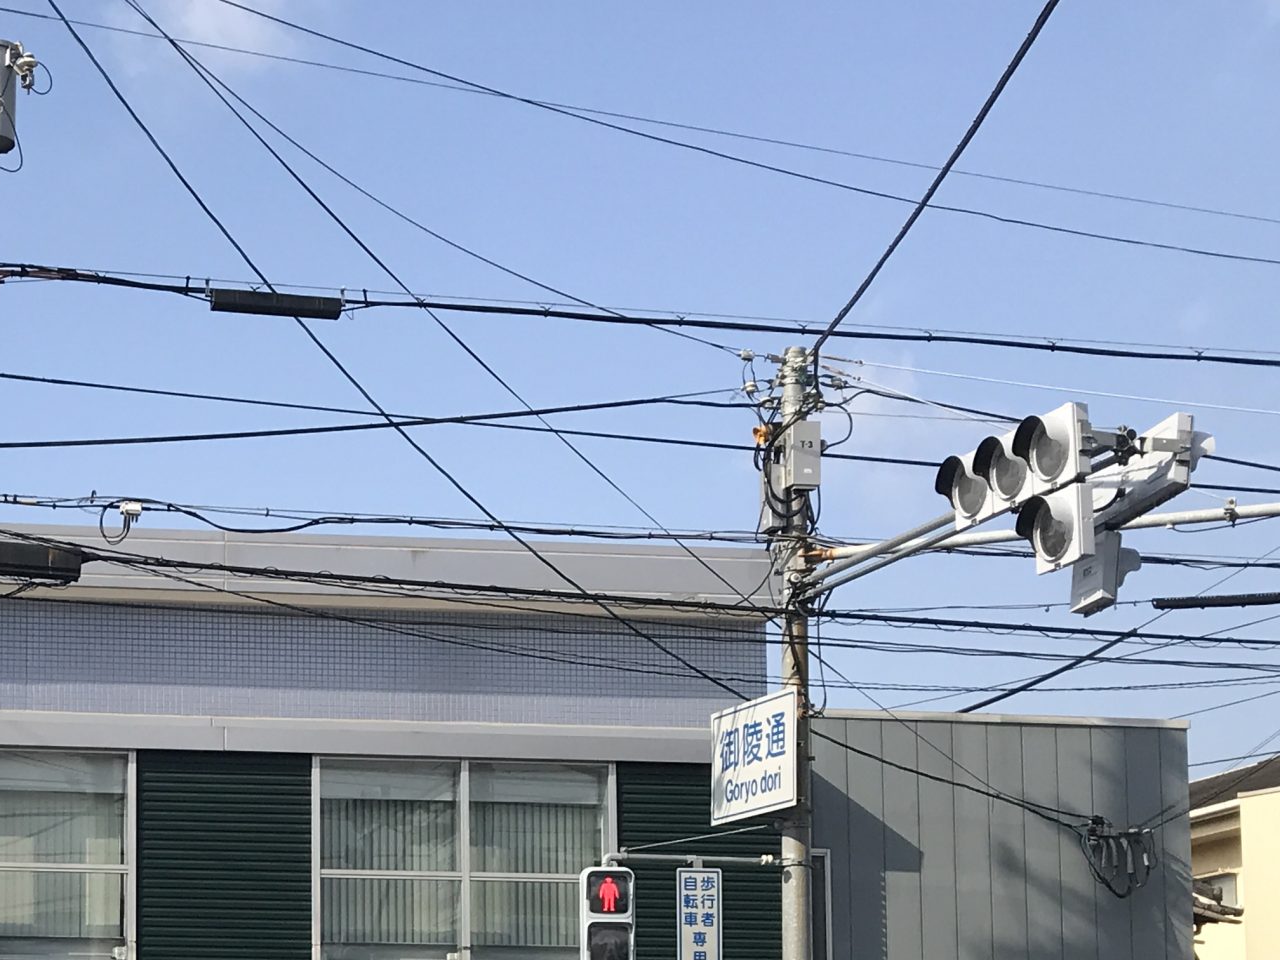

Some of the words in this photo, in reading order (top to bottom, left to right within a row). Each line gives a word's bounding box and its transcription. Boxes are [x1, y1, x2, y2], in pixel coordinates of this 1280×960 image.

[720, 711, 786, 774] 御陵通
[725, 778, 758, 803] Goryo
[760, 765, 782, 793] dori
[683, 875, 699, 927] 自転車
[700, 875, 716, 927] 歩行者
